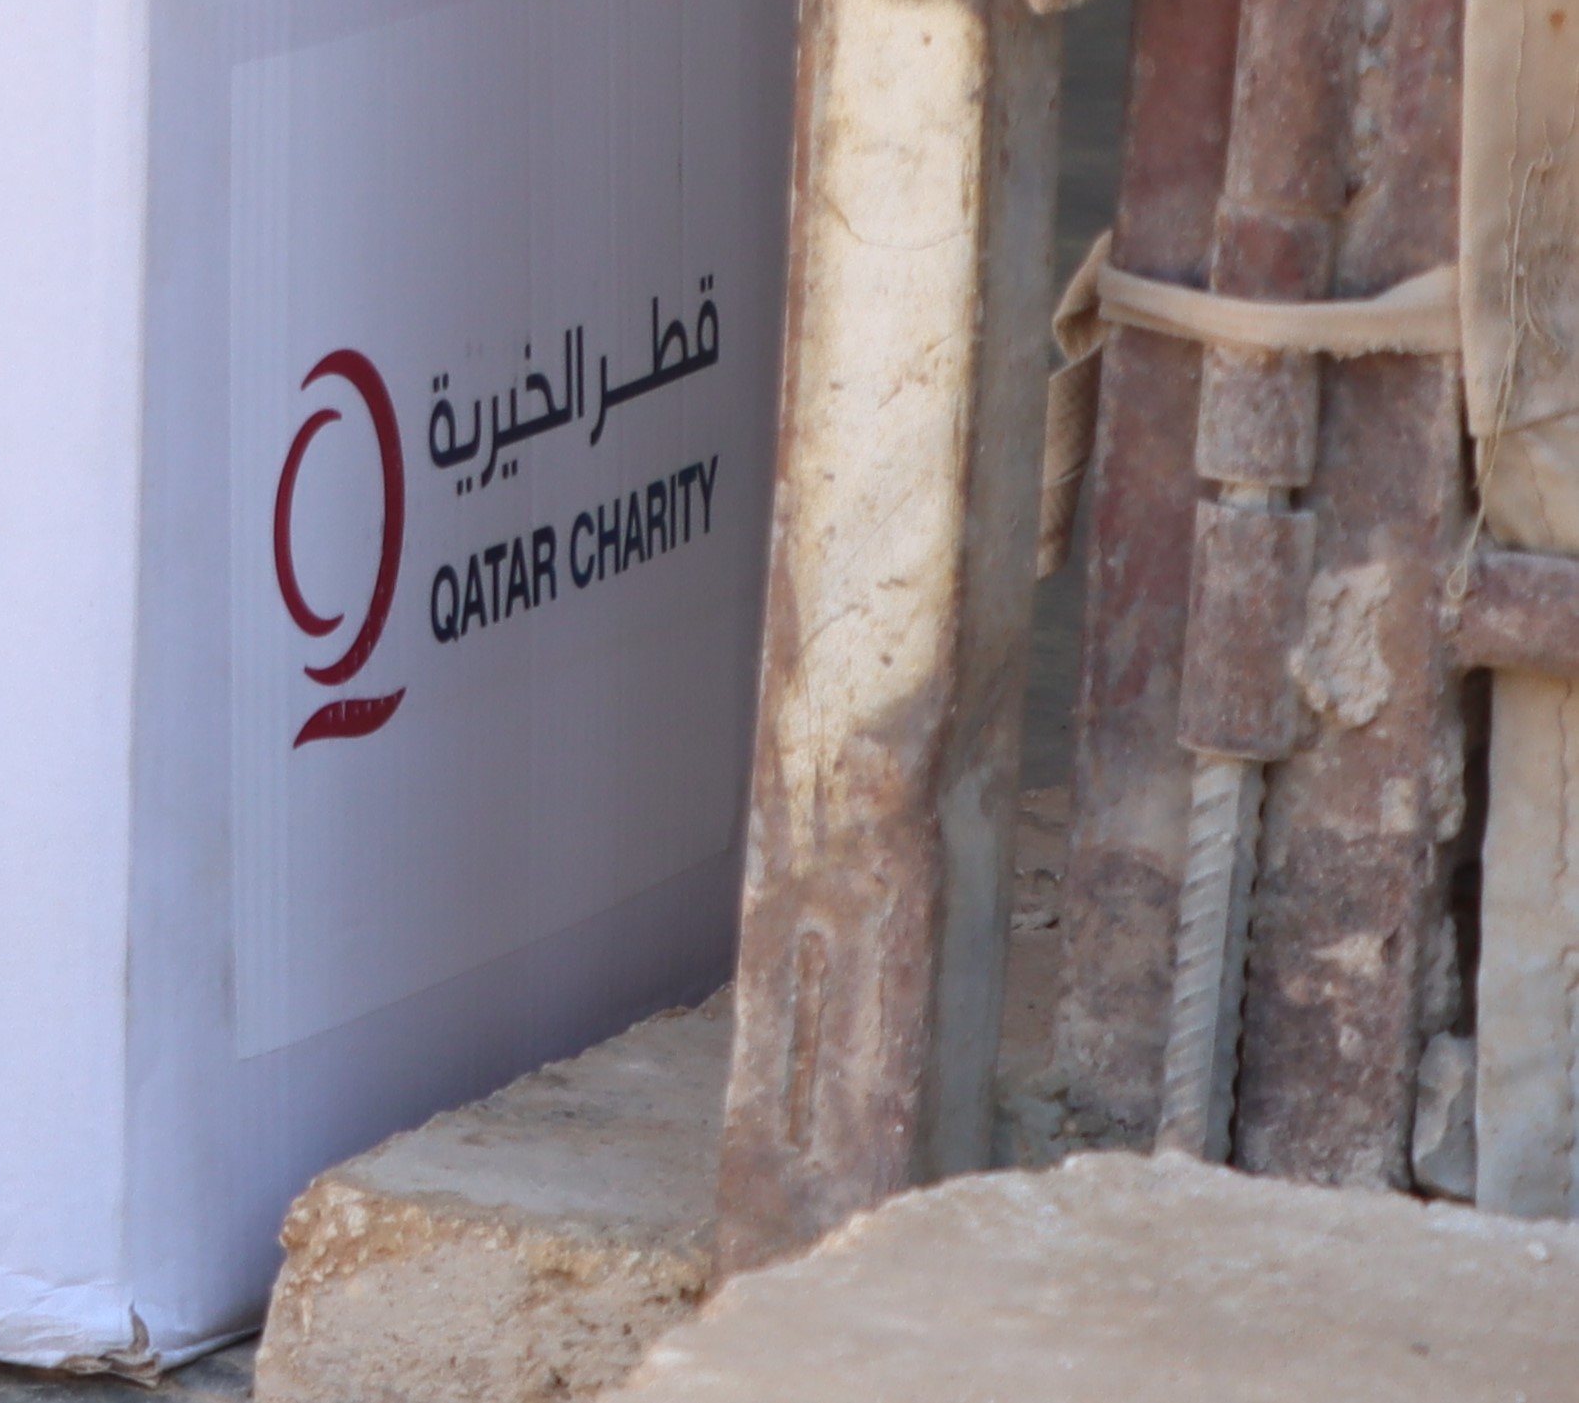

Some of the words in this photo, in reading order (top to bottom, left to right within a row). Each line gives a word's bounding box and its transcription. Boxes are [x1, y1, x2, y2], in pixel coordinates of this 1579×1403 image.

[429, 326, 584, 496] الخيرية
[590, 274, 720, 447] قطر
[431, 524, 558, 644] QATAR
[570, 454, 719, 589] CHARITY
